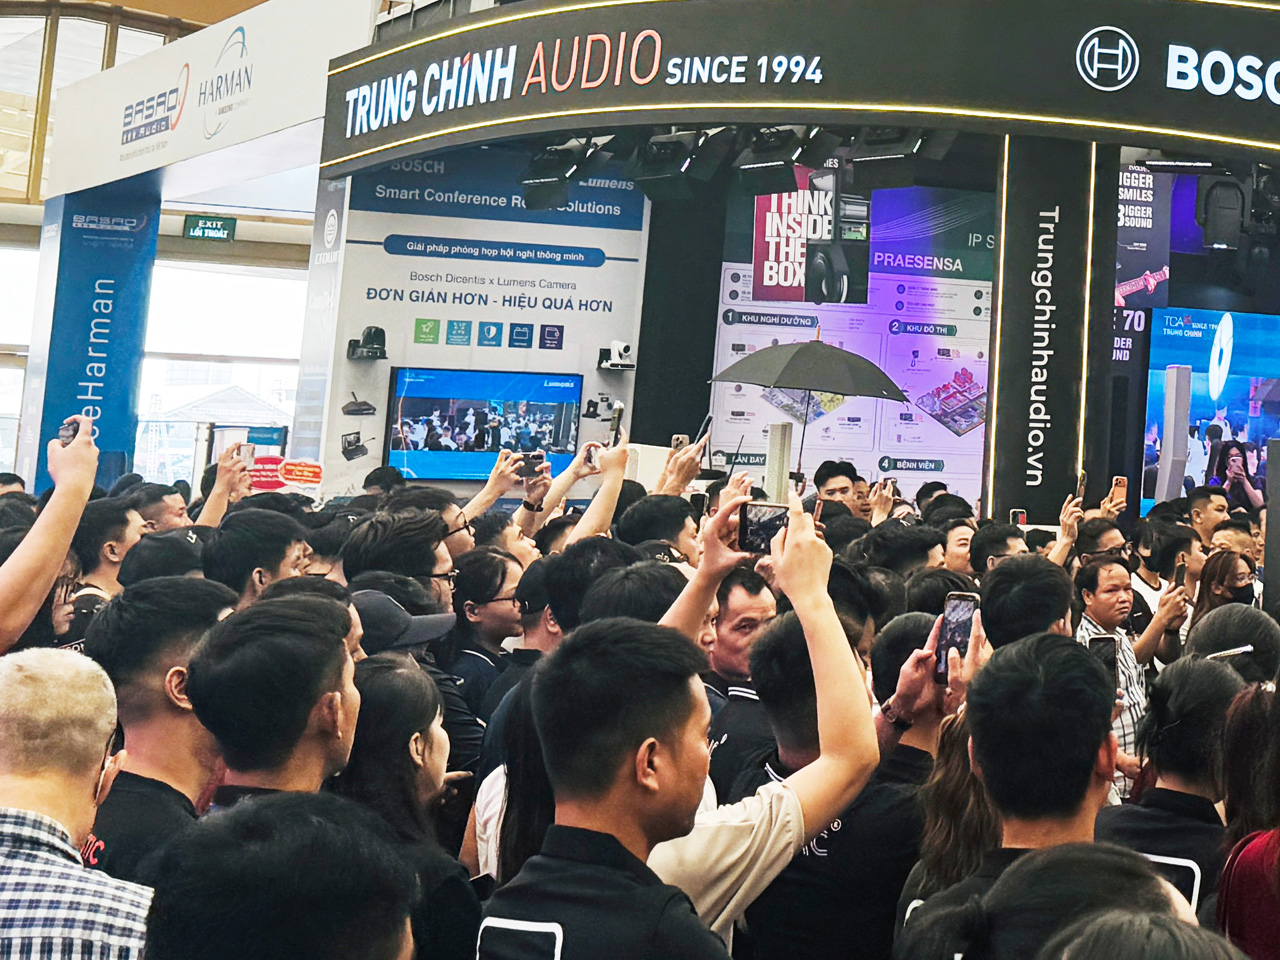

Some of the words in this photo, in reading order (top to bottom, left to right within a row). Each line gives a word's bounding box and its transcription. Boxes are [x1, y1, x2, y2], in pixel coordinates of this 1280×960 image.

[665, 56, 748, 85] SINCE
[757, 55, 823, 83] 1994
[198, 64, 253, 107] HARMAN
[346, 69, 418, 138] TRUNG
[521, 29, 662, 96] AUDIO
[391, 159, 445, 174] BOSCH
[1119, 172, 1154, 188] IGGER
[375, 184, 420, 200] Smart
[424, 188, 507, 206] Conference
[771, 189, 833, 215] THINK
[1118, 188, 1154, 202] SMILES
[198, 220, 224, 228] EXIT
[765, 212, 833, 240] INSIDE
[1125, 217, 1152, 228] SOUND
[968, 232, 982, 246] IP
[426, 243, 449, 254] pháp
[536, 250, 561, 261] thông
[563, 253, 584, 261] minh
[765, 236, 807, 262] THE
[873, 252, 963, 272] PRAESENSA
[410, 271, 443, 283] Bosch
[445, 273, 486, 285] Dicentis
[497, 276, 536, 288] Lumens
[539, 279, 577, 290] Camera
[763, 260, 806, 287] BOX
[366, 287, 404, 301] ĐƠN
[452, 292, 489, 306] HƠN
[502, 293, 538, 310] HIỆU
[579, 299, 613, 313] HƠN
[727, 312, 733, 321] 1
[742, 314, 758, 322] KHU
[1123, 310, 1145, 331] 70
[1164, 315, 1184, 327] TCA
[892, 322, 899, 331] 2
[907, 325, 922, 333] KHU
[1163, 328, 1182, 337] TRUNG
[1025, 205, 1060, 486] Trungchinhaudio.vn
[1114, 337, 1132, 349] DER
[882, 459, 889, 469] 4
